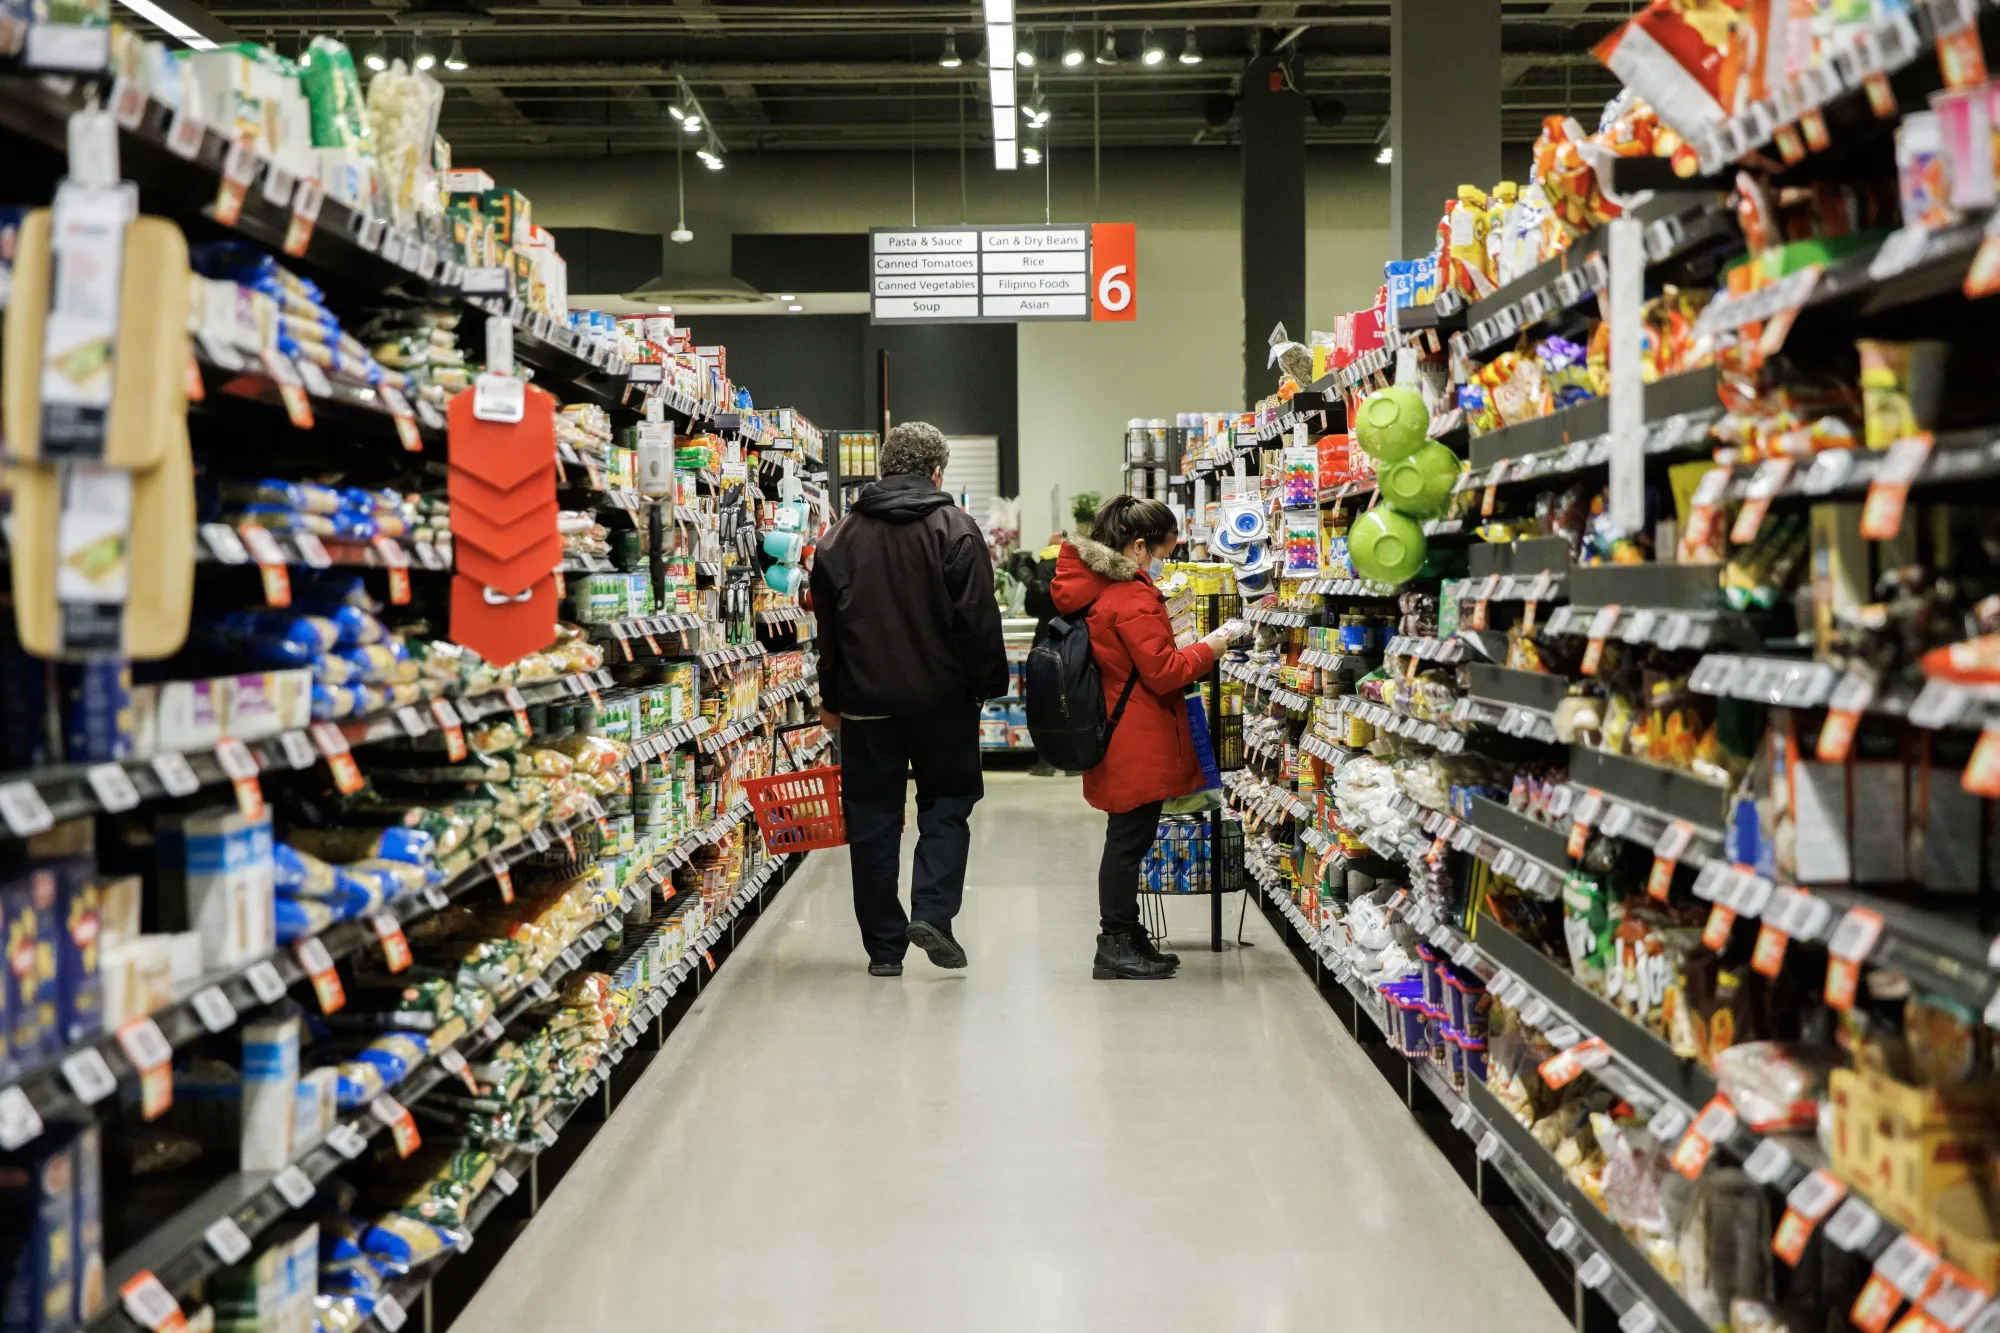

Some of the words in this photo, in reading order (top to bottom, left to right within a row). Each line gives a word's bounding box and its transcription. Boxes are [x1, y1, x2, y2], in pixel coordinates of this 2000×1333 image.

[889, 236, 917, 246] Pasta
[920, 237, 928, 246] &
[931, 236, 963, 246] Sauce
[988, 236, 1009, 246] Can
[1013, 236, 1021, 246] &
[1024, 236, 1043, 248] Dry
[1046, 236, 1078, 246] Beans
[877, 258, 919, 269] Canned
[920, 258, 974, 268] Tomatoes
[1023, 257, 1045, 266] Rice
[877, 280, 918, 291] Canned
[919, 279, 975, 292] Vegetables
[999, 279, 1037, 291] Filipino
[1039, 279, 1070, 288] Foods
[1099, 265, 1131, 312] 6
[913, 301, 941, 312] Soup
[1020, 300, 1049, 309] Asian
